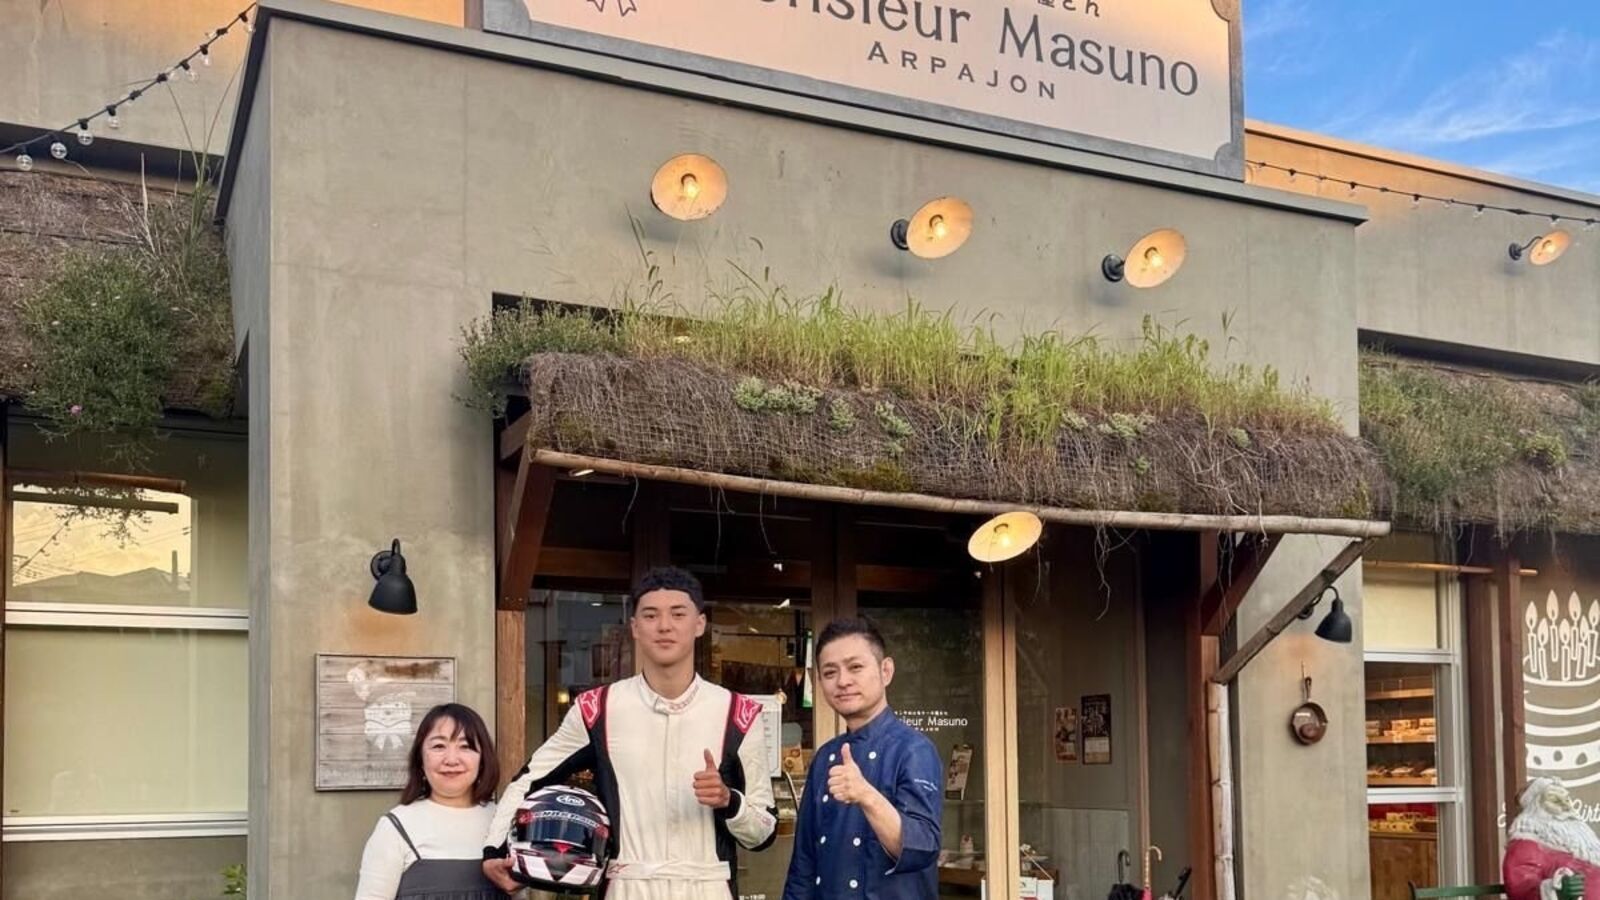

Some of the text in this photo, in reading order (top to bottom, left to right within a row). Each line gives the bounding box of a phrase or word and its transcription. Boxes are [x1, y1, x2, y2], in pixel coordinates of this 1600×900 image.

[867, 41, 1055, 99] ARPAJON
[999, 8, 1198, 96] Masuno
[927, 716, 968, 726] Masuno
